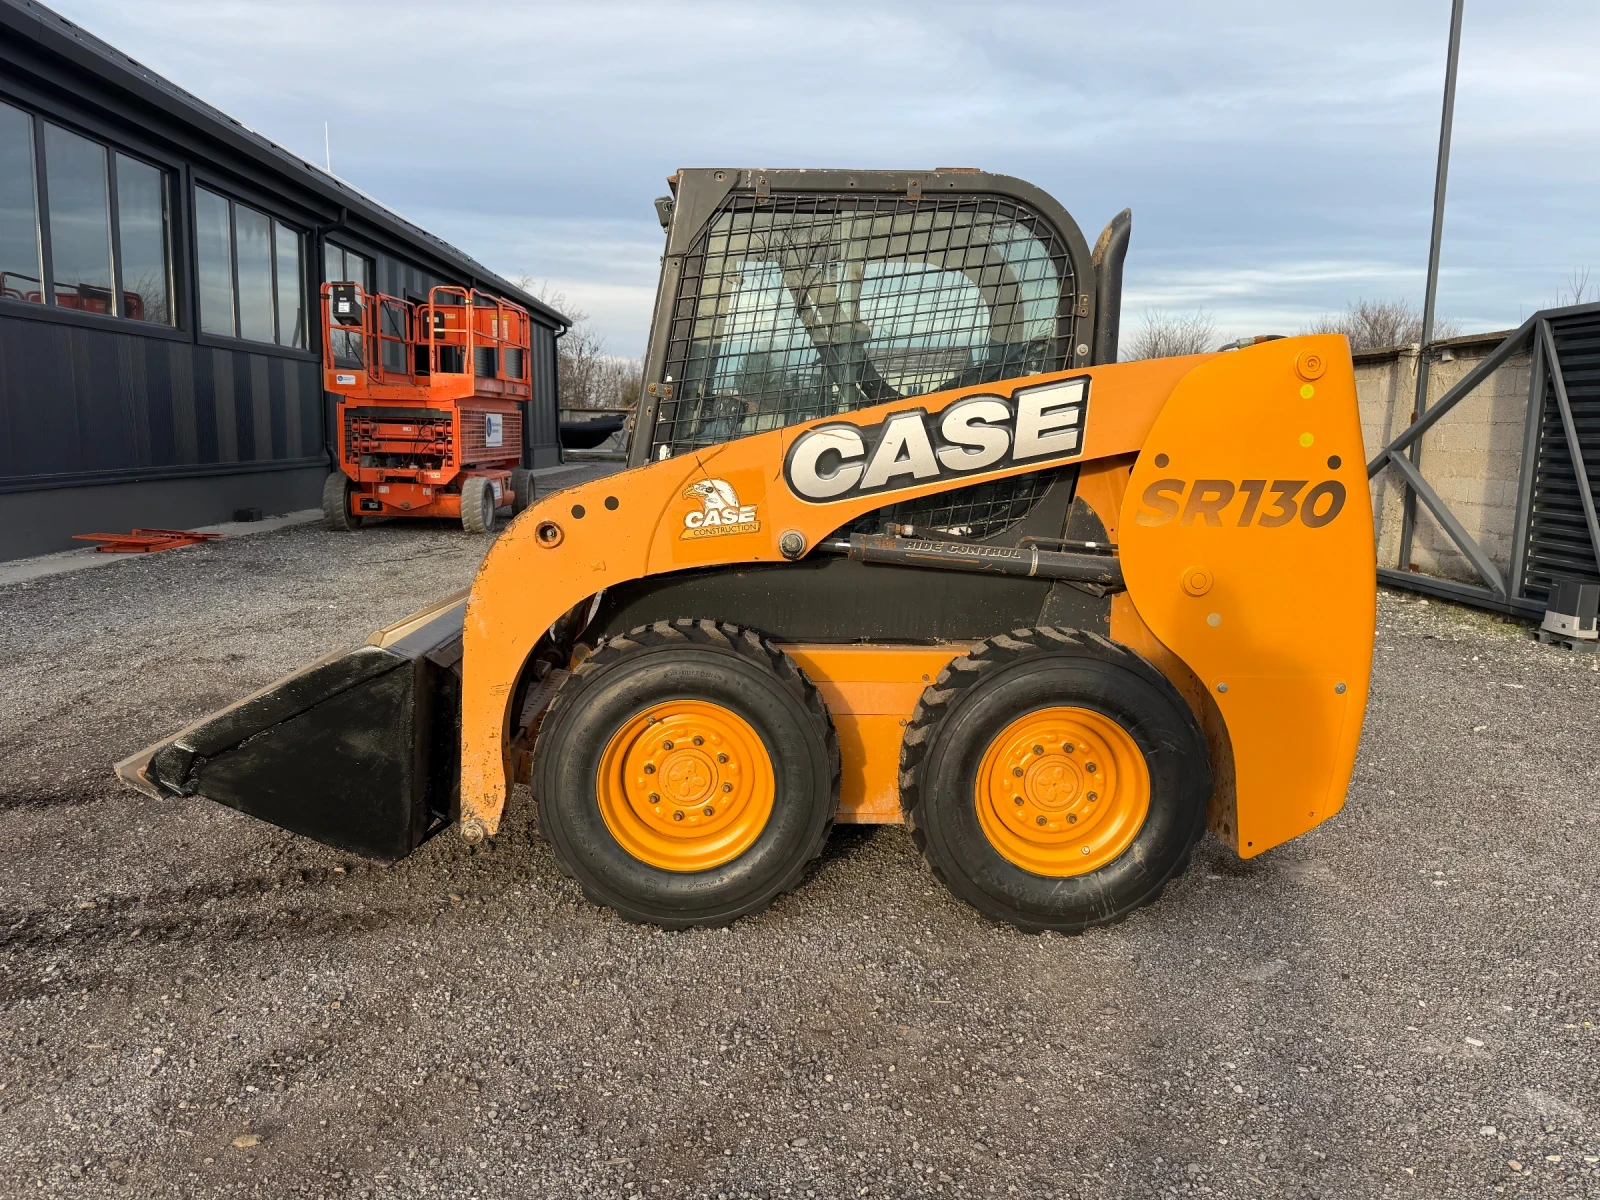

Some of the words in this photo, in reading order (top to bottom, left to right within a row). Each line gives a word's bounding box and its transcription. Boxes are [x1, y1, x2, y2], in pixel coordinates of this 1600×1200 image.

[788, 381, 1087, 499] CASE
[1134, 478, 1347, 528] SR130
[684, 505, 758, 528] CASE
[693, 523, 757, 537] CONSTRUCTION
[904, 540, 943, 554] RIDE
[946, 542, 1021, 559] CONTROL
